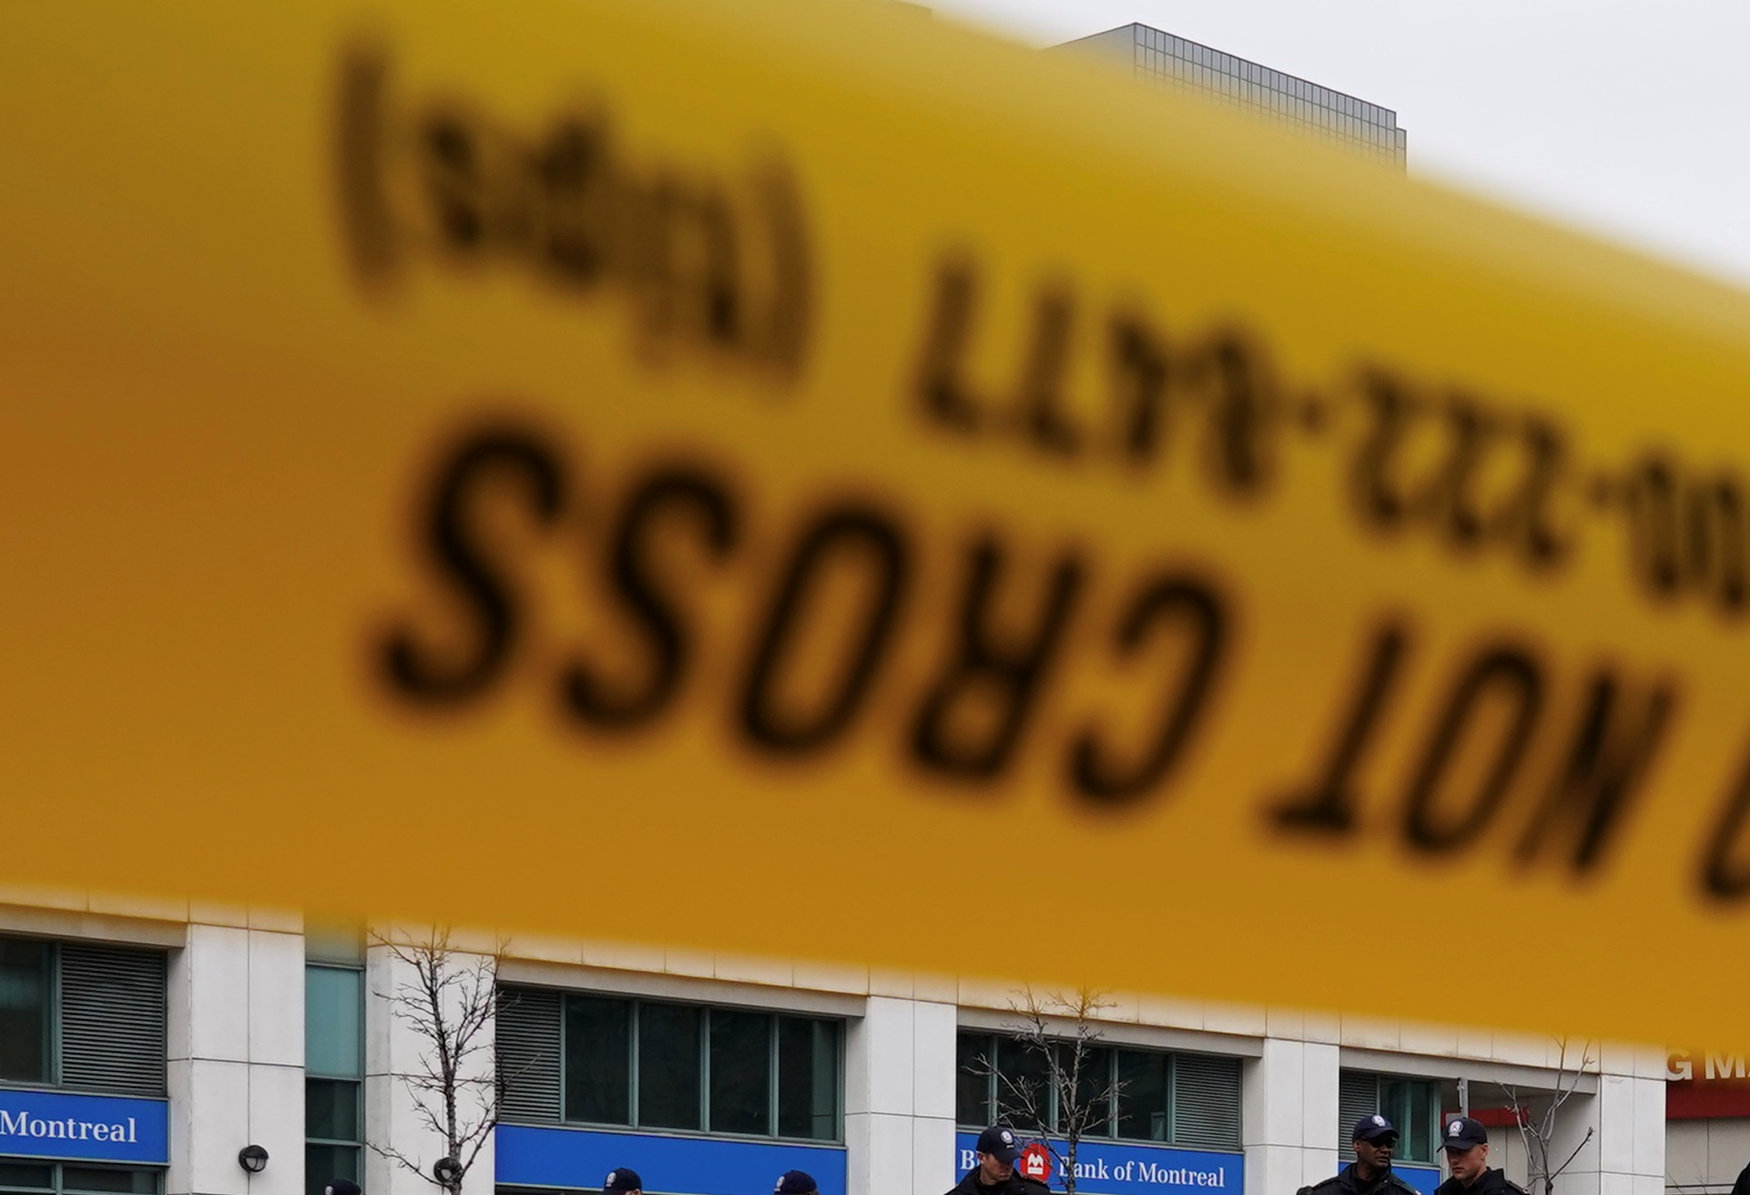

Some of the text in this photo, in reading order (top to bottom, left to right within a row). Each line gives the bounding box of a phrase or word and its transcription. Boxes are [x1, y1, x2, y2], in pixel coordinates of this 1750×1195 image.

[368, 420, 1240, 812] CROSS
[1262, 618, 1678, 888] NOT
[0, 1109, 138, 1143] Montreal
[1059, 1156, 1226, 1188] Bank of Montreal
